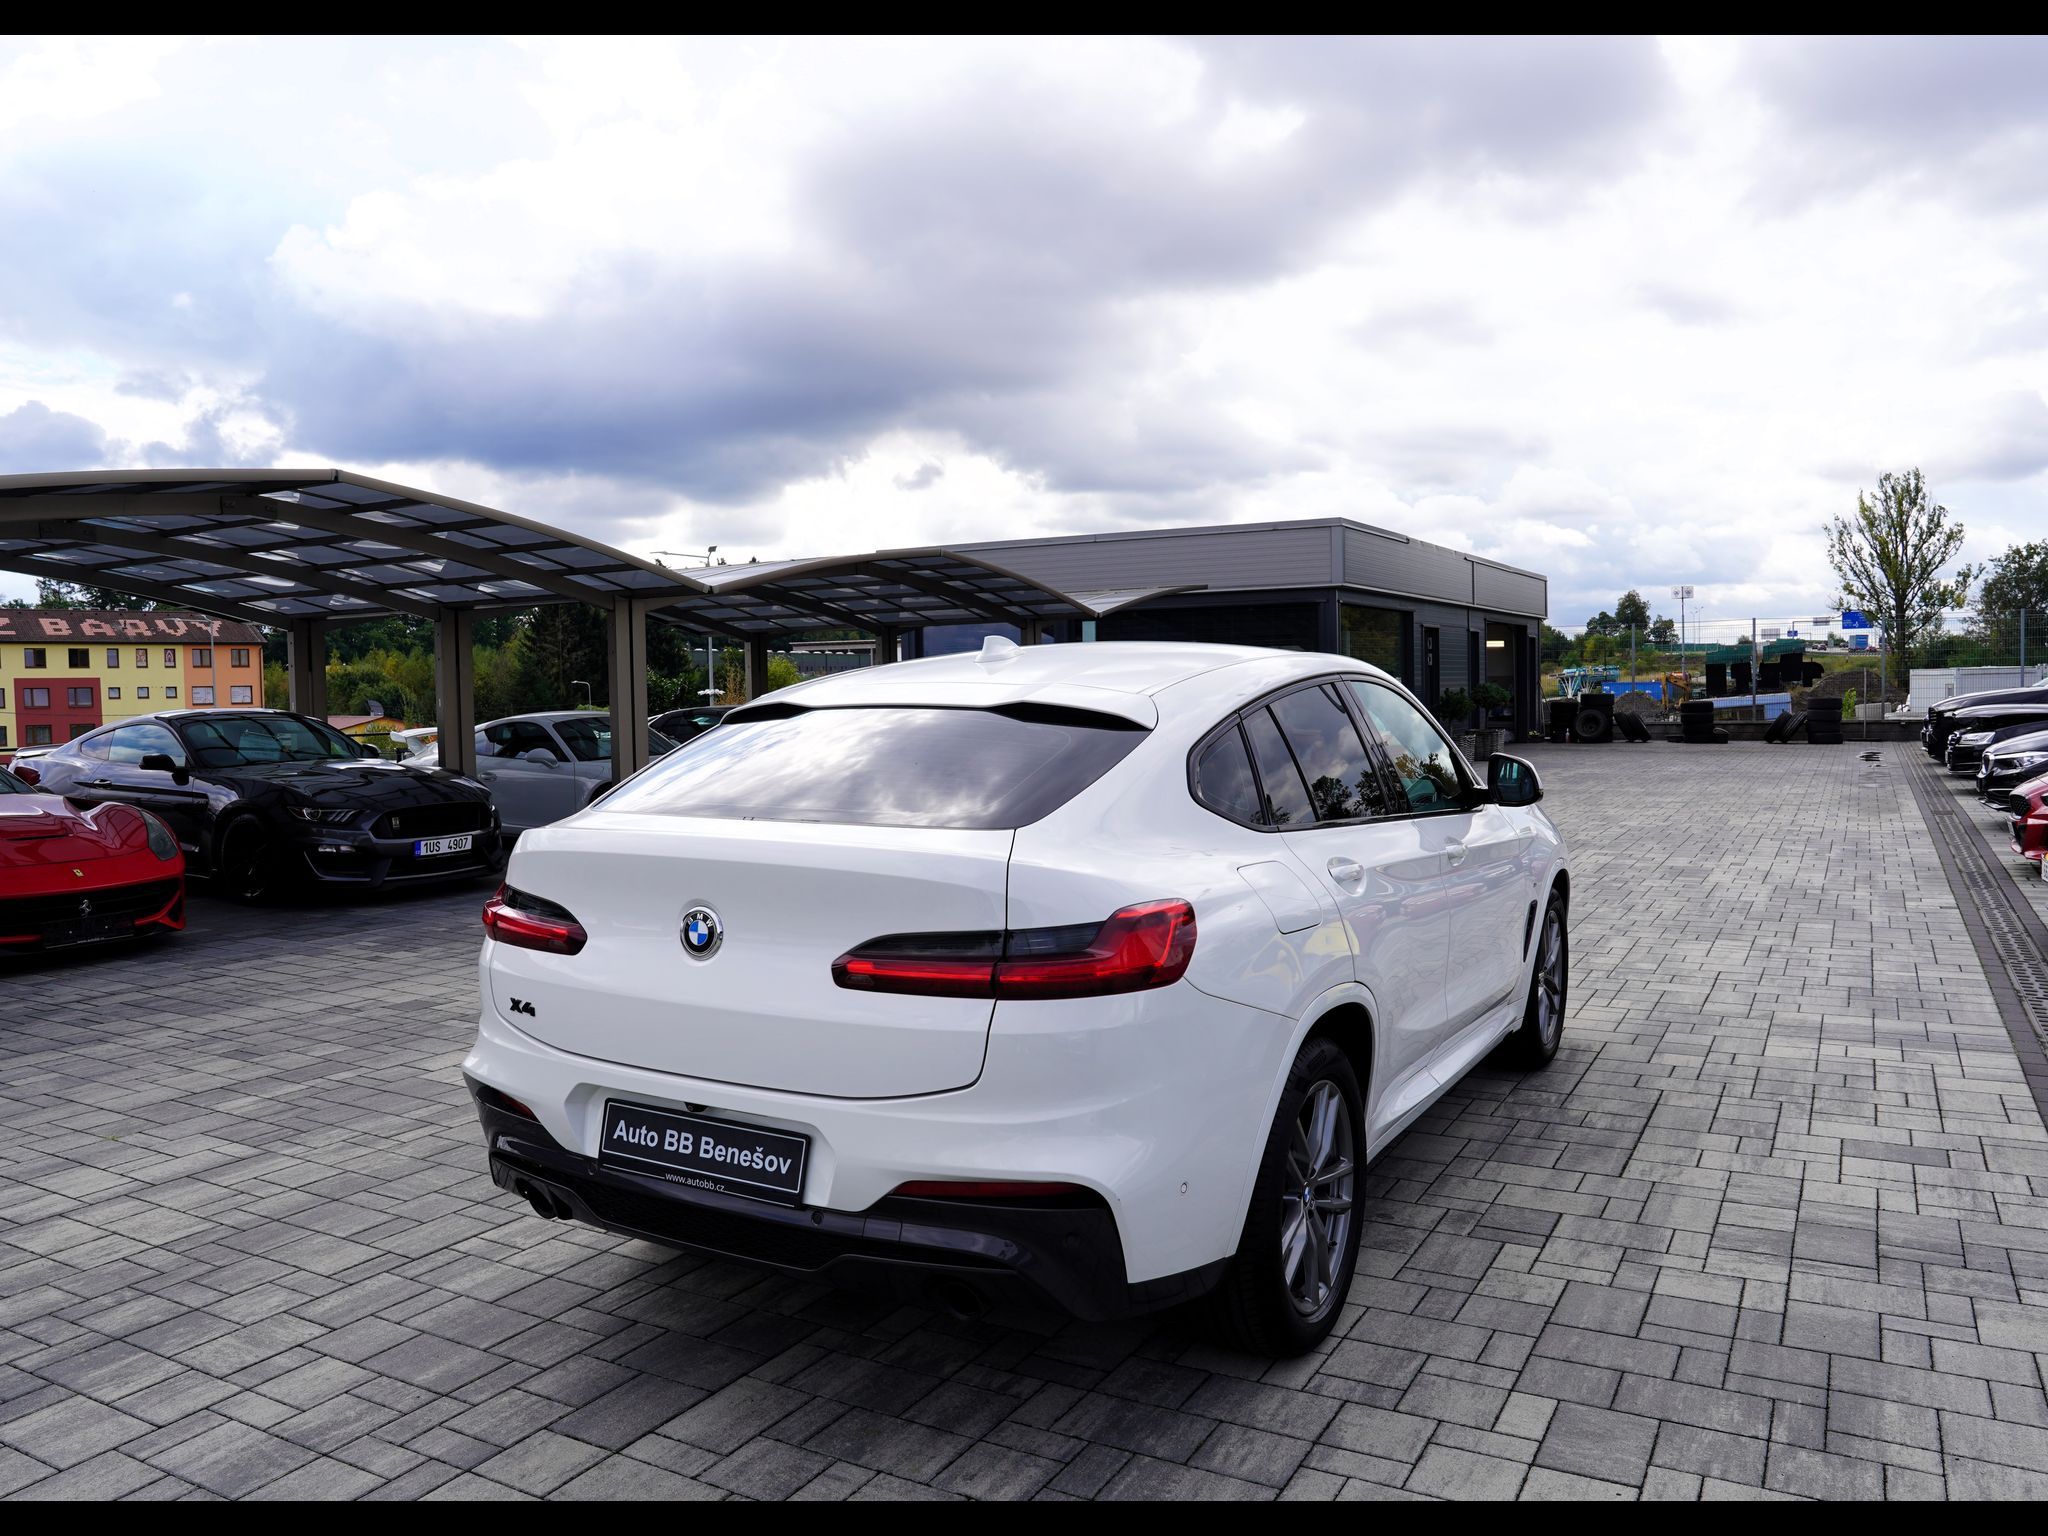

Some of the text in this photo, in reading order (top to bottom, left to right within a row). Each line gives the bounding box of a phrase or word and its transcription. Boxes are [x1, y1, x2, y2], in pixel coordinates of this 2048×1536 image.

[423, 837, 469, 854] 1US 4907
[509, 996, 536, 1017] X4
[612, 1119, 792, 1175] Auto BB Benešov
[664, 1172, 725, 1192] www.autobb.cz
